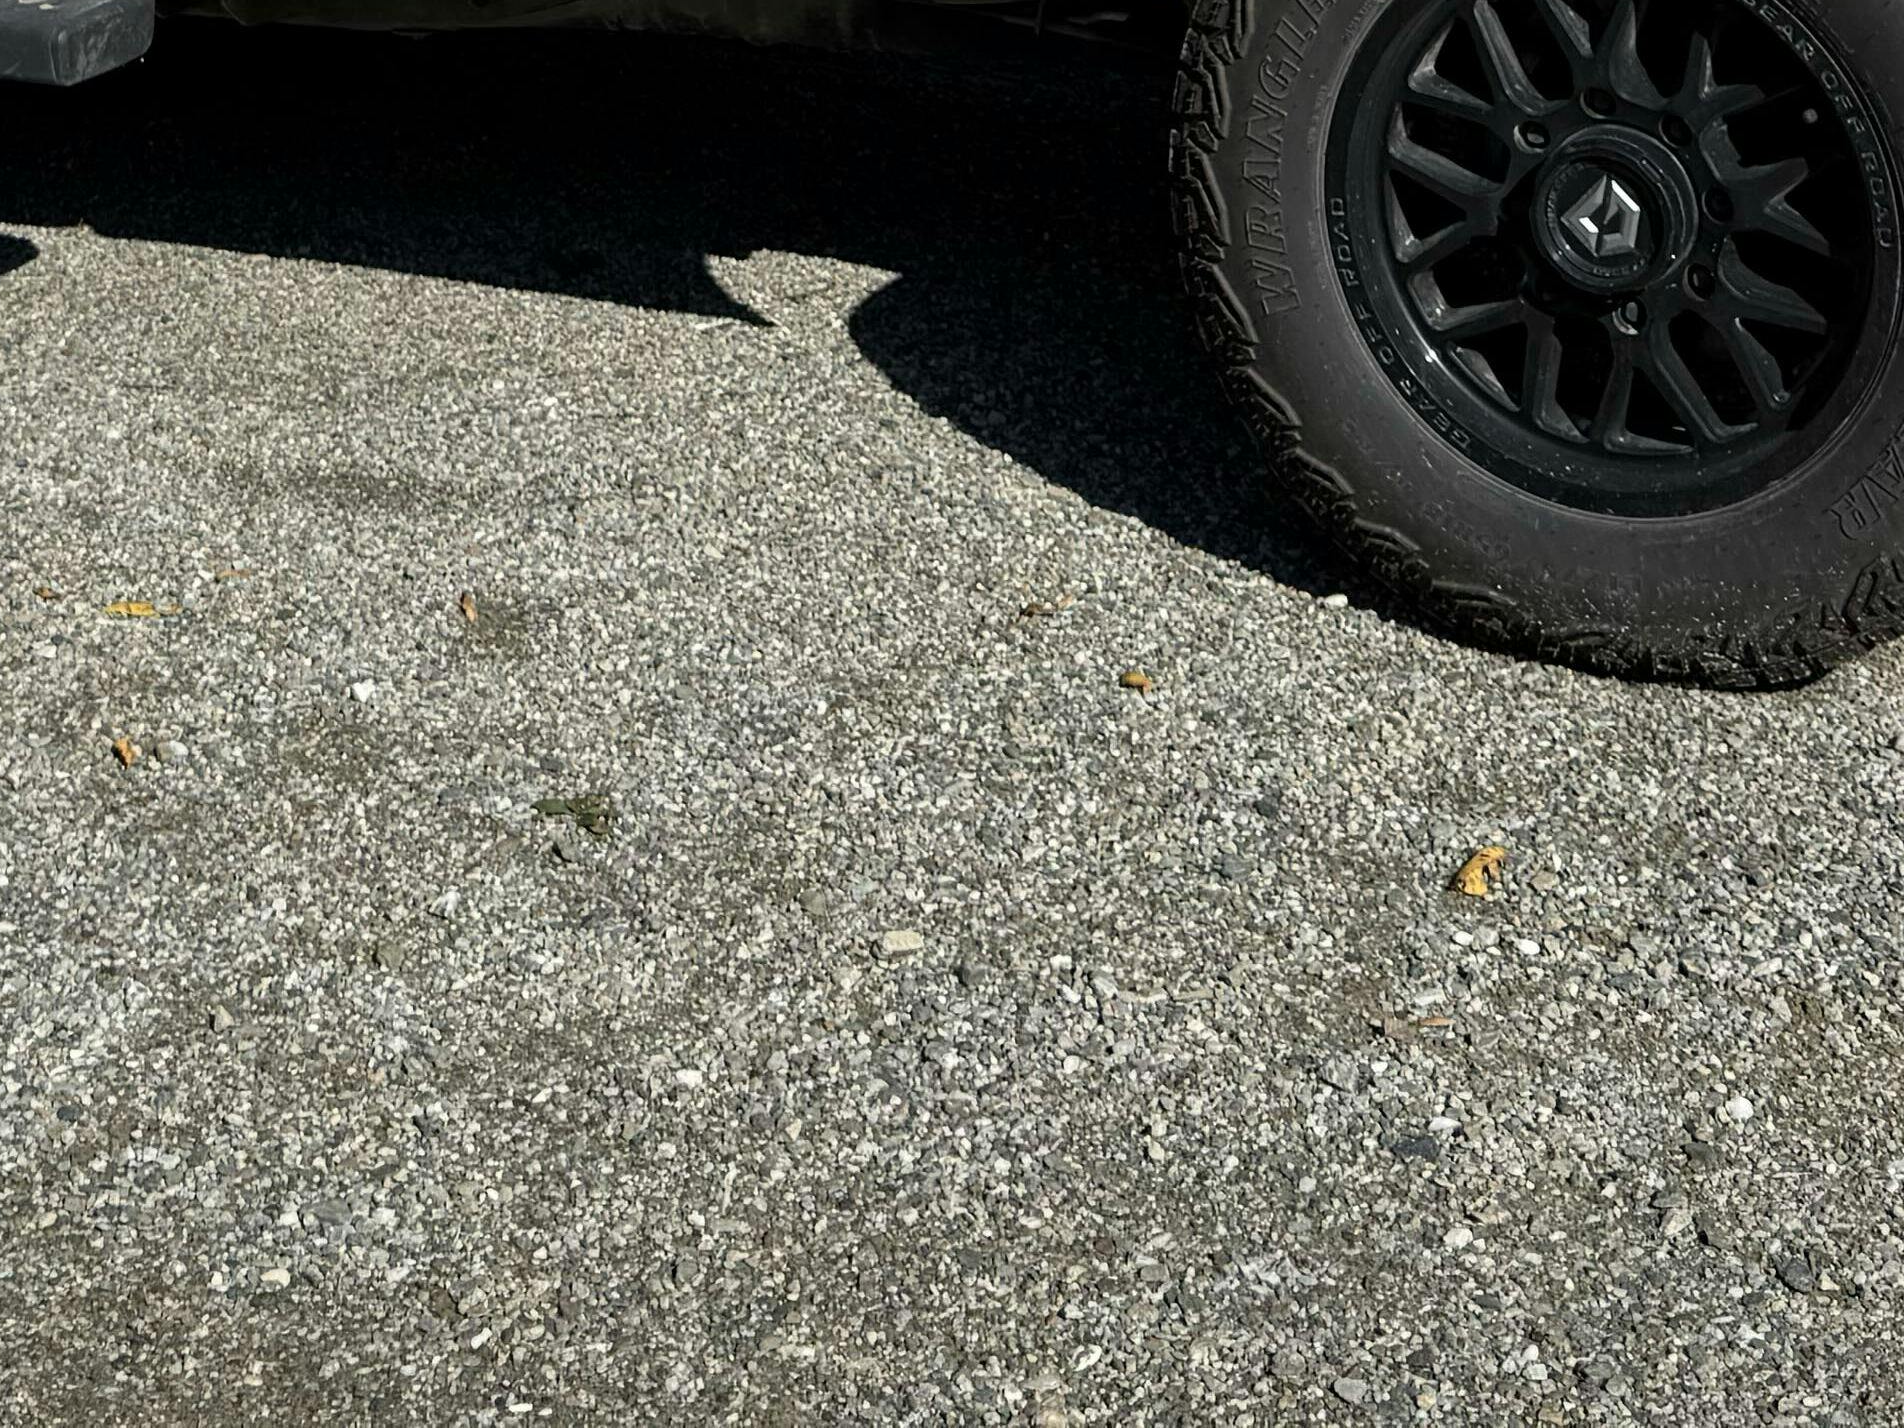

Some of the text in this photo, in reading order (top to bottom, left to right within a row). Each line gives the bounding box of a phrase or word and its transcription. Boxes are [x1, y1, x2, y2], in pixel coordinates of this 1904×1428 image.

[1821, 70, 1866, 134] OFF
[1861, 151, 1893, 249] ROAD
[1329, 196, 1360, 288] ROAD
[1354, 302, 1396, 366] OFF
